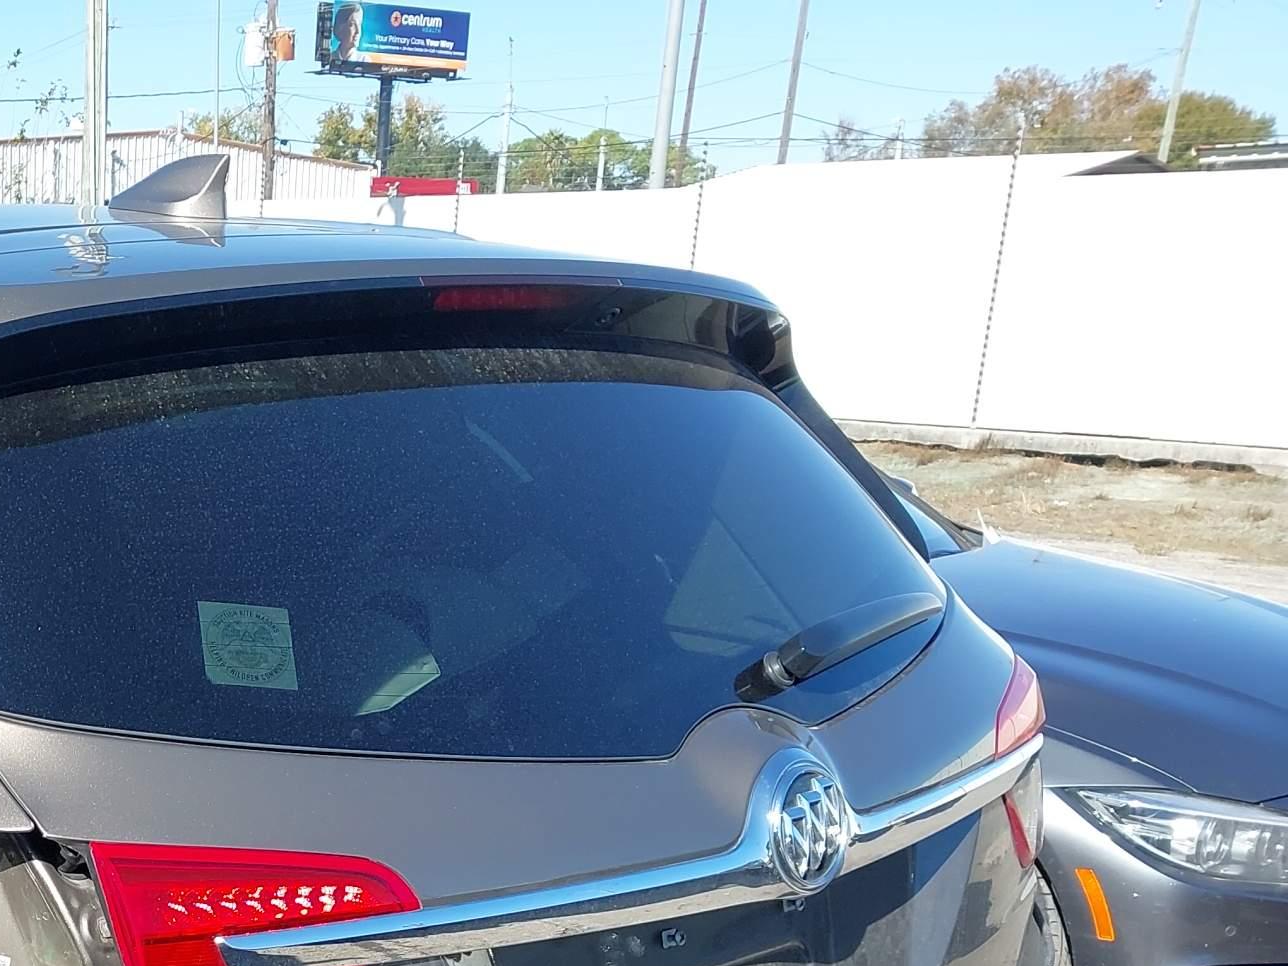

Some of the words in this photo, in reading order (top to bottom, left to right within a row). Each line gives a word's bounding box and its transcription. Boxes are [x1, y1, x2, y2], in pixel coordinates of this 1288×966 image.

[401, 13, 443, 28] centrum
[375, 34, 388, 43] Your
[388, 35, 410, 47] Primary
[425, 38, 439, 48] Your
[439, 39, 455, 50] Way
